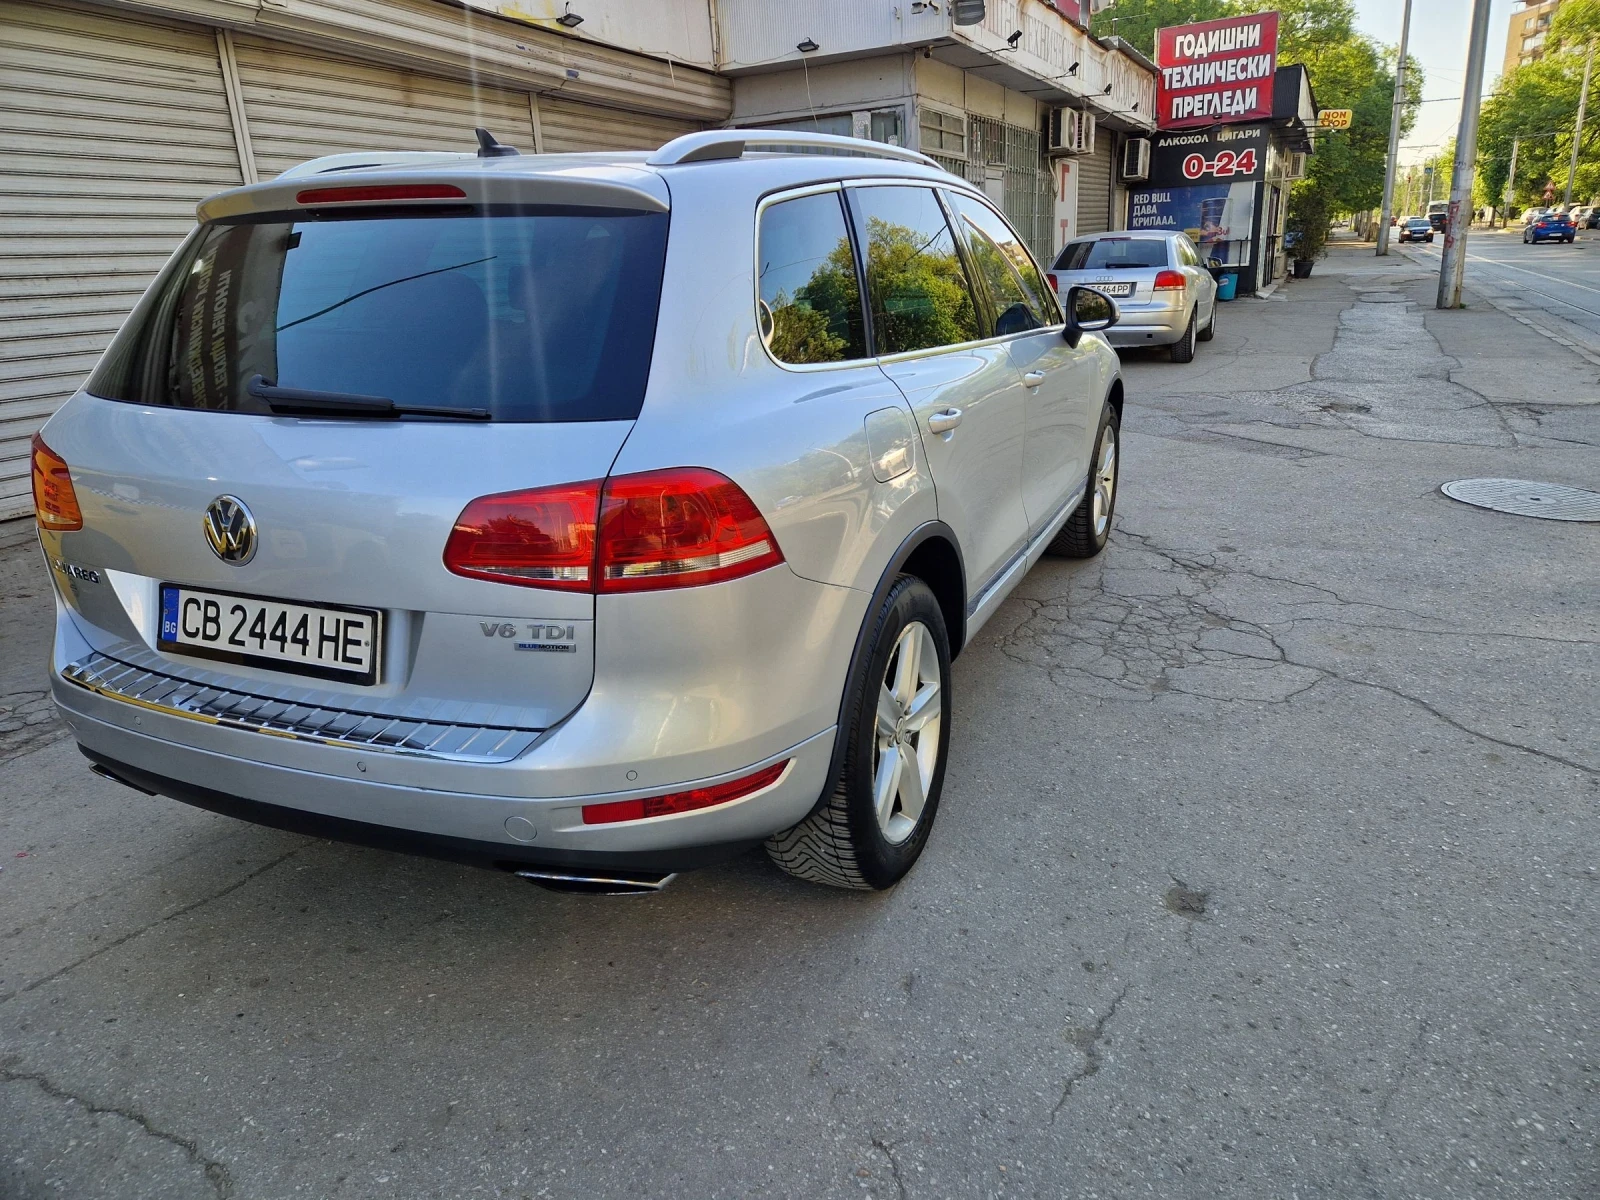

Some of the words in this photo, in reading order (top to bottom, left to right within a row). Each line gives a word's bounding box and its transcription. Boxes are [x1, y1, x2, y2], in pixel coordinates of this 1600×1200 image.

[1175, 24, 1261, 58] ГОДИШНИ
[1163, 54, 1271, 90] ТЕХНИЧЕСКИ
[1171, 88, 1257, 119] ПРЕГЛЕДИ
[1320, 119, 1347, 127] STOP
[1324, 111, 1347, 119] NON
[1158, 134, 1209, 148] АЛКОХОЛ
[1216, 129, 1261, 143] ЦИГАРИ
[1182, 148, 1257, 180] 0-24
[1133, 194, 1150, 205] RED
[1151, 192, 1172, 203] BULL
[1133, 204, 1158, 217] ДАВА
[1132, 216, 1177, 228] КРИЛААА.
[164, 620, 176, 634] BG
[228, 604, 310, 656] 2444
[479, 621, 517, 639] V6
[527, 625, 575, 641] TDI
